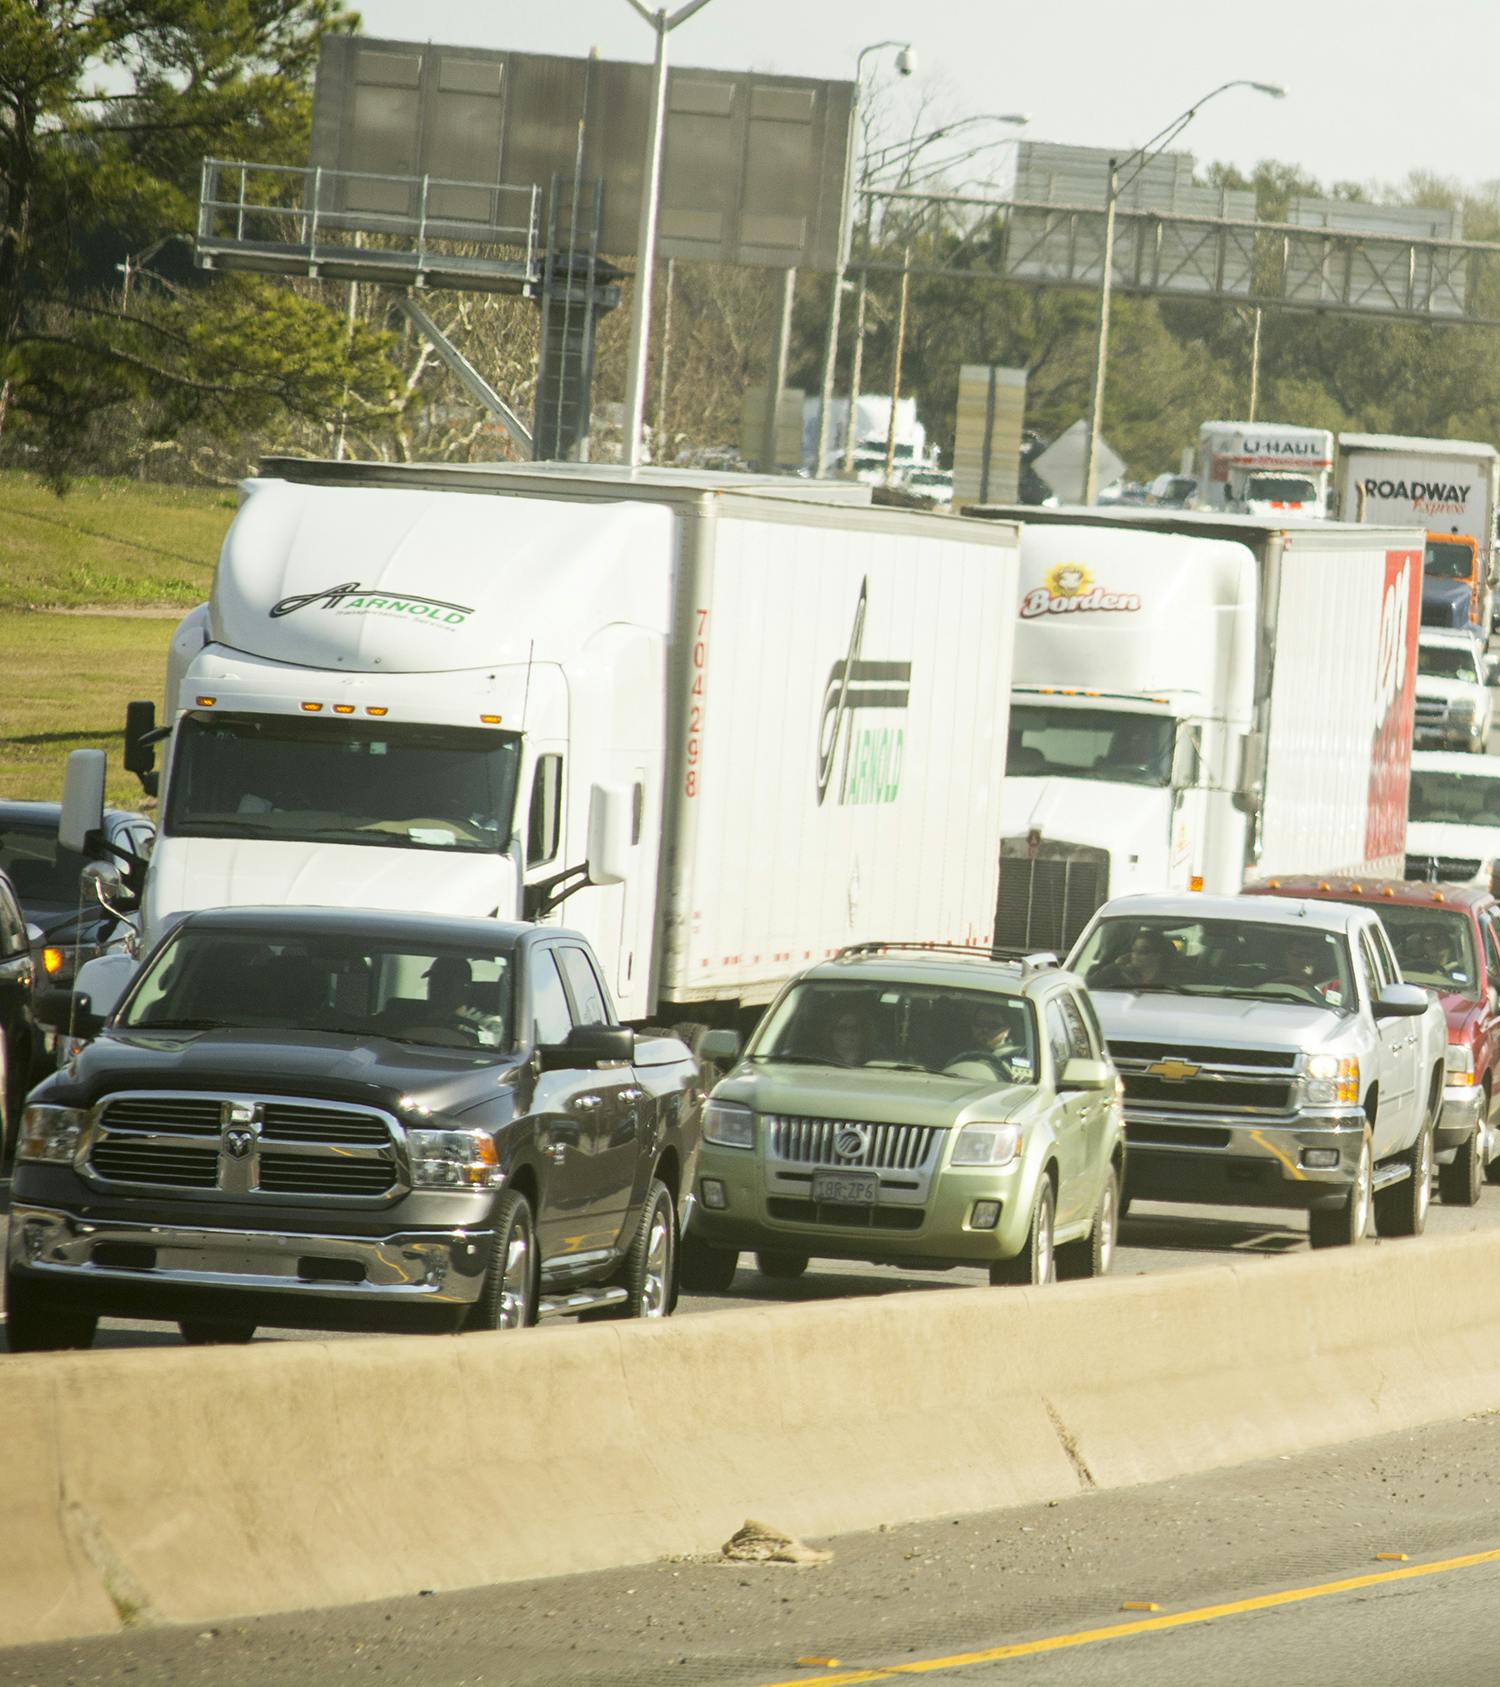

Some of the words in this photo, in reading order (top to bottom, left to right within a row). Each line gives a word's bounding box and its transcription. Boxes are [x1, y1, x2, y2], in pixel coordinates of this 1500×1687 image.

[1364, 478, 1471, 503] ROADWAY
[1412, 497, 1466, 516] Express
[345, 598, 466, 625] ARNOLD
[1020, 586, 1141, 618] Borden
[685, 609, 707, 798] 704298
[847, 728, 904, 805] ARNOLD
